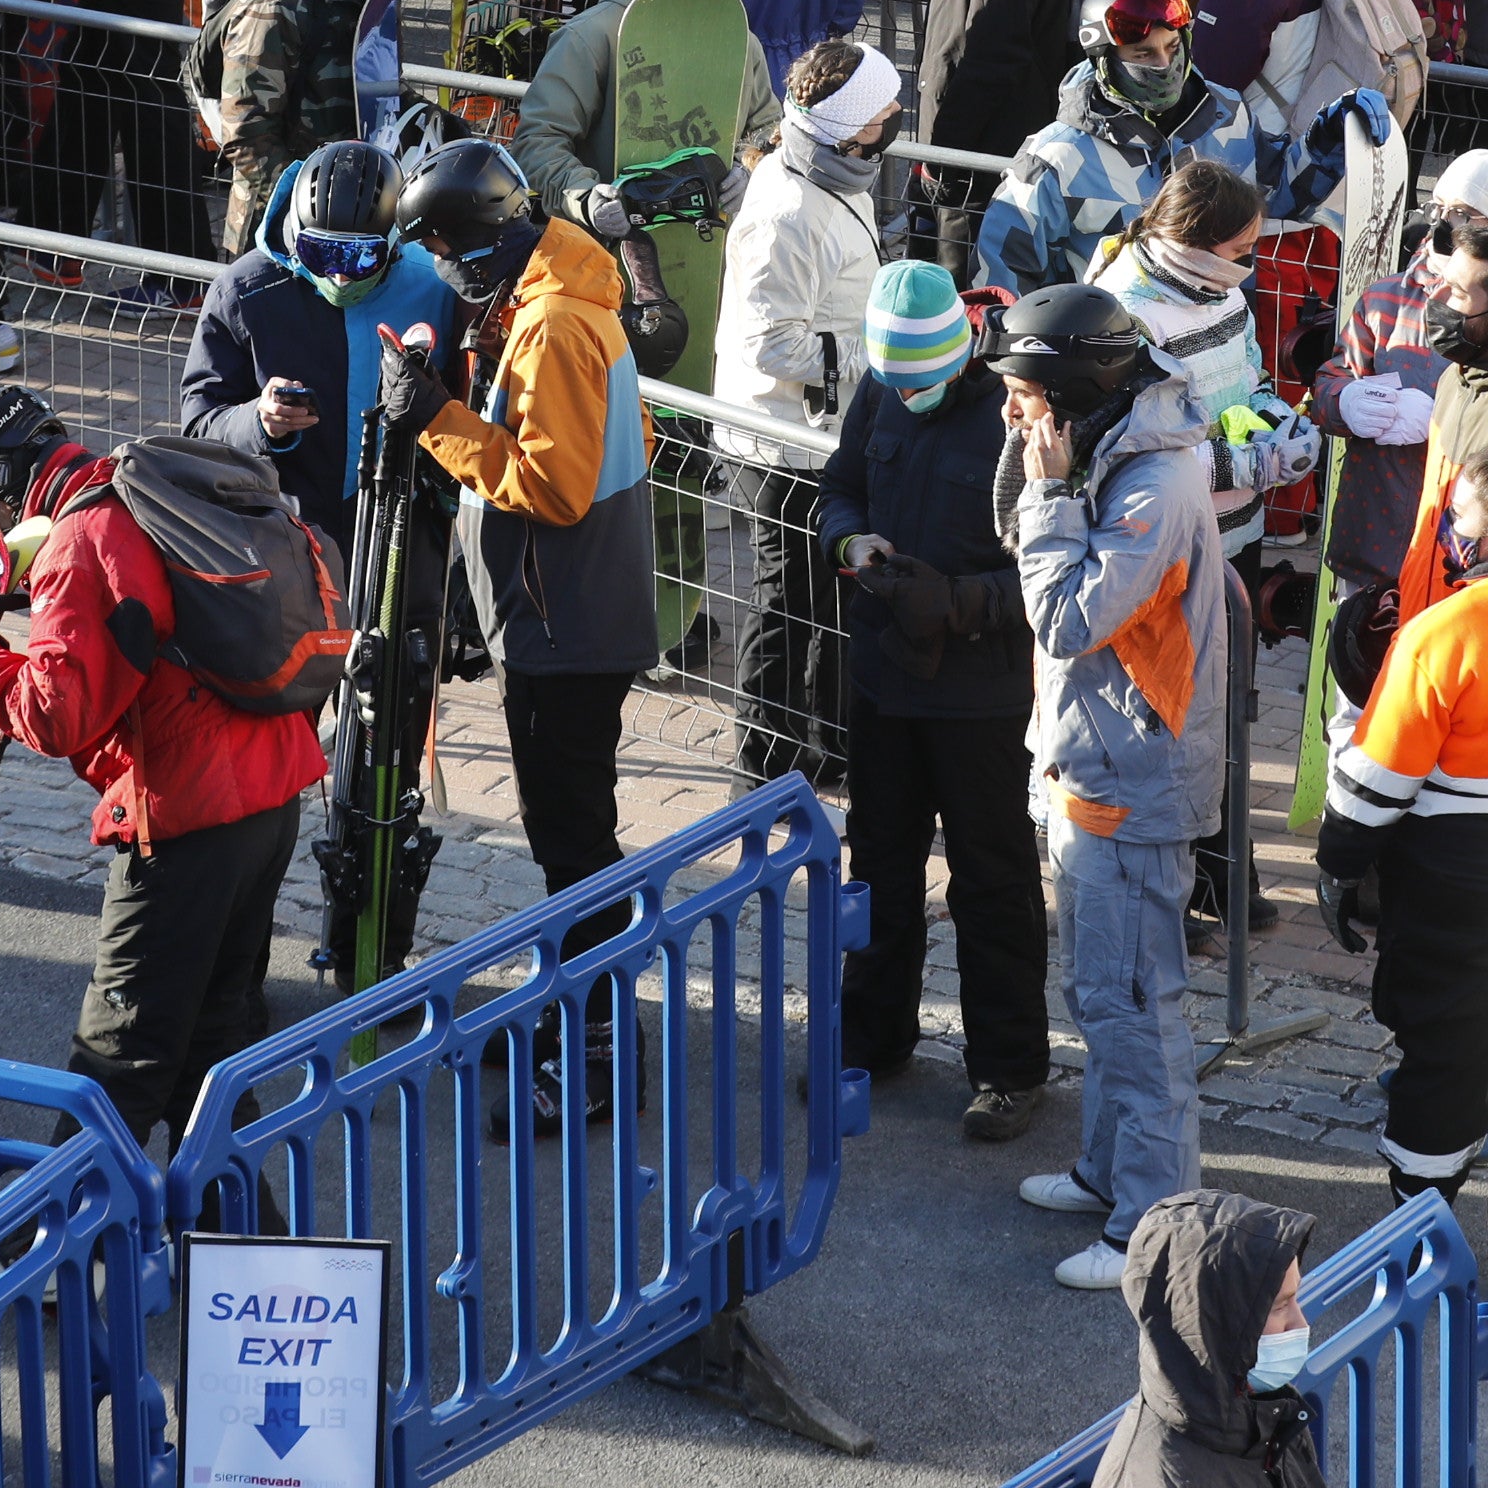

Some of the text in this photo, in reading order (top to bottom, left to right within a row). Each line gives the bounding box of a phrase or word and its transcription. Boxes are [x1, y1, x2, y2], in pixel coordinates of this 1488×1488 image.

[208, 1292, 358, 1324] SALIDA
[238, 1337, 332, 1366] EXIT
[214, 1472, 301, 1488] sierranevada
